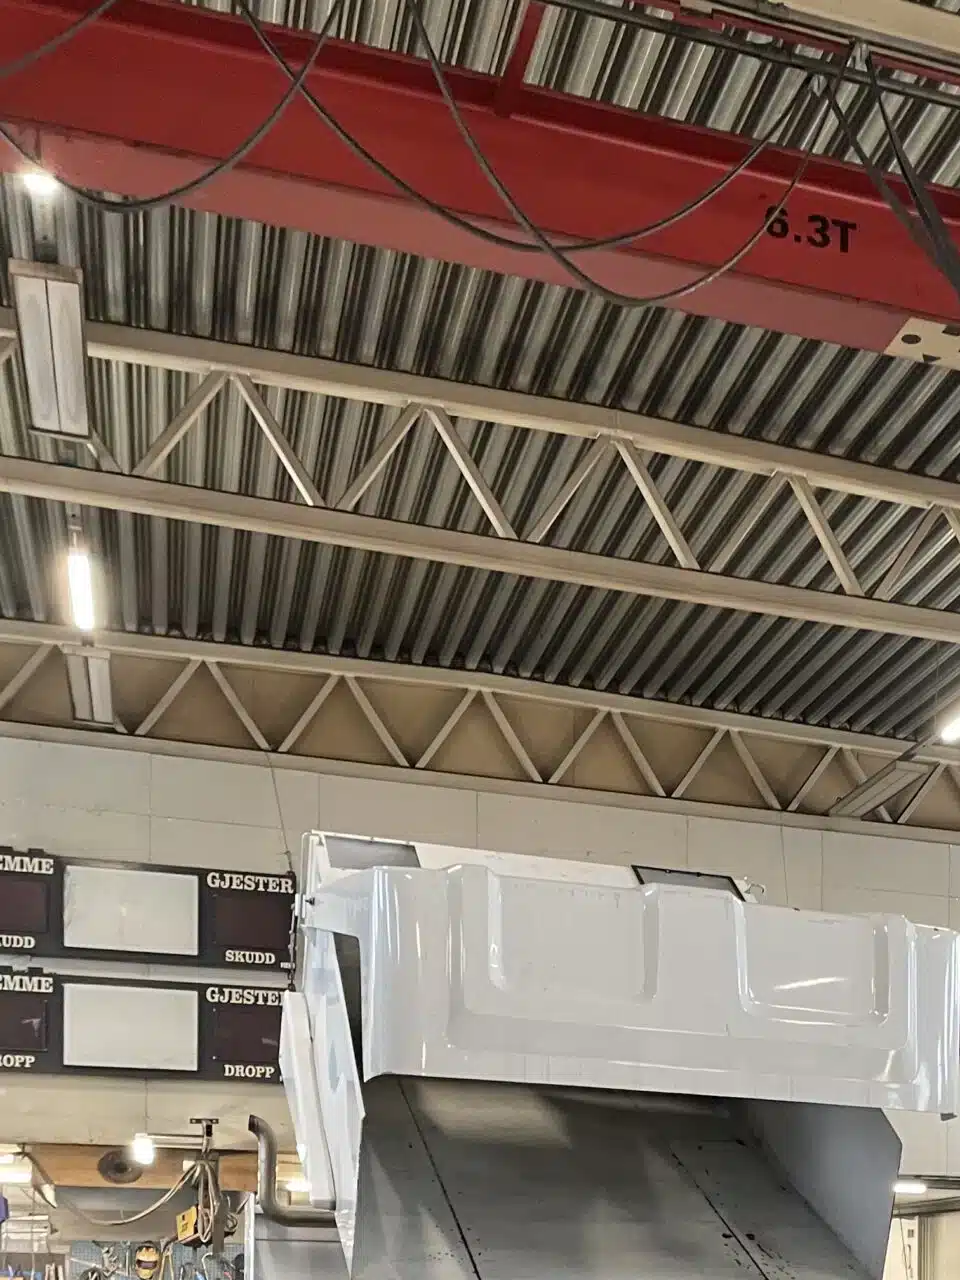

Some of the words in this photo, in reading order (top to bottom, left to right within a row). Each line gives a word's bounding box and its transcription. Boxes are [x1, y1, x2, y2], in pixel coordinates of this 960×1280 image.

[764, 205, 857, 253] 6.3T
[0, 854, 54, 875] MME
[206, 871, 294, 894] GJESTER
[0, 934, 36, 949] UDD
[225, 949, 276, 965] SKUDD
[0, 974, 54, 993] MME
[205, 986, 284, 1006] GJESTE
[0, 1054, 36, 1068] OPP
[223, 1064, 275, 1078] DROPP
